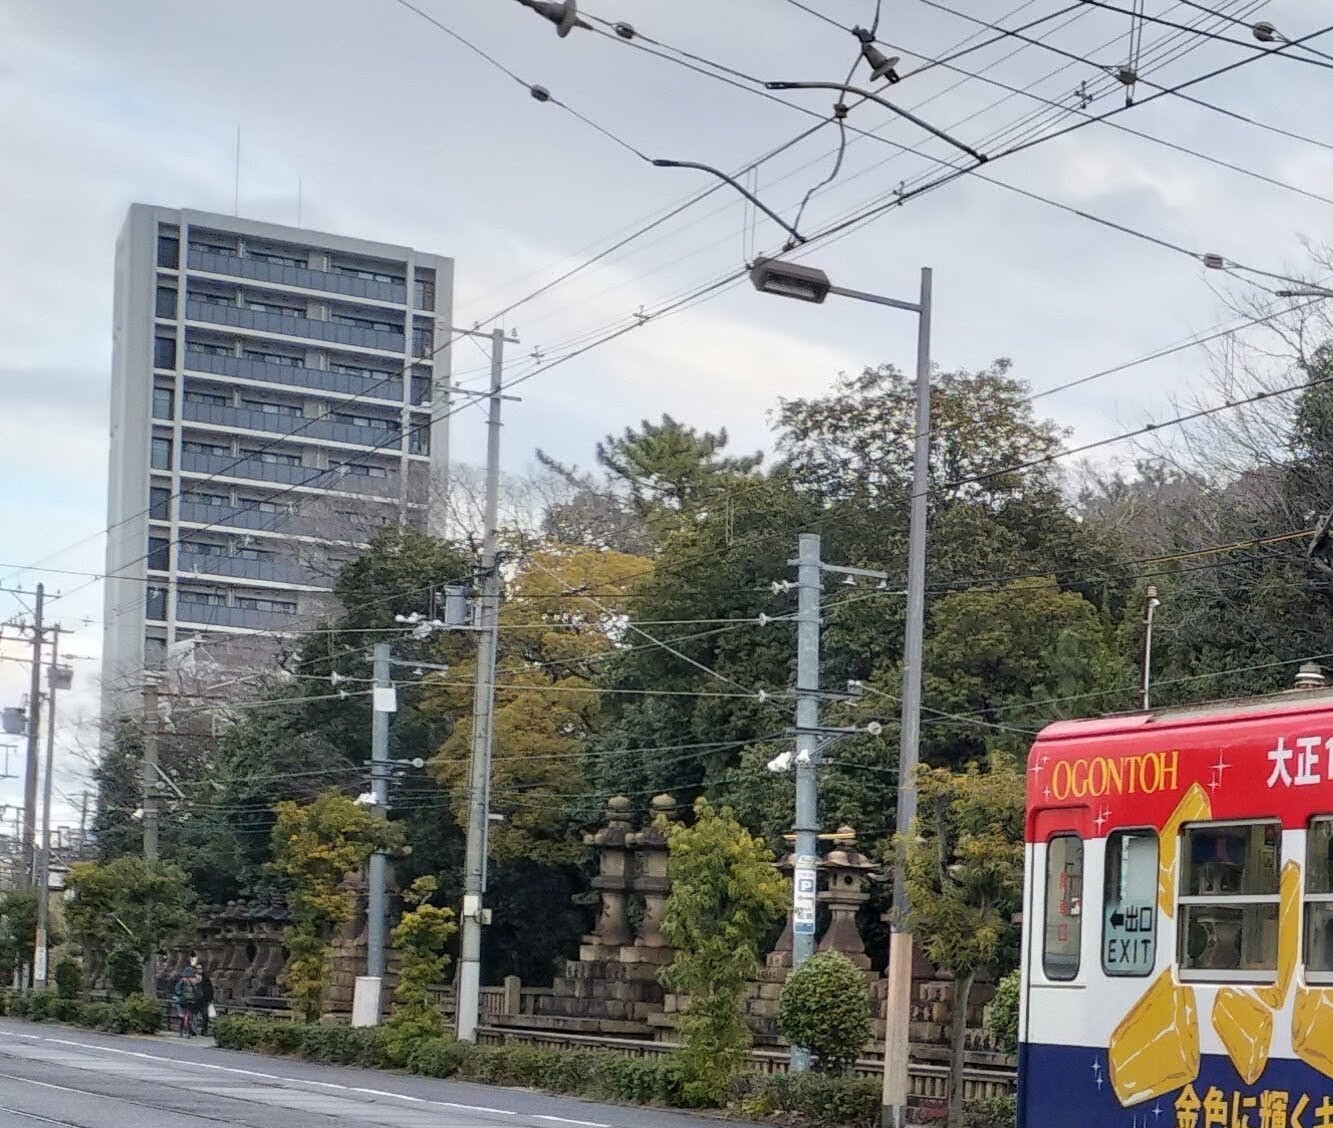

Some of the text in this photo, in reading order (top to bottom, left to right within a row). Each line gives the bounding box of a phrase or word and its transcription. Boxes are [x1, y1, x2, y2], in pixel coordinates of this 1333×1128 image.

[1052, 750, 1179, 800] OGONTOH
[1125, 905, 1153, 932] 出口
[1108, 938, 1151, 964] EXIT
